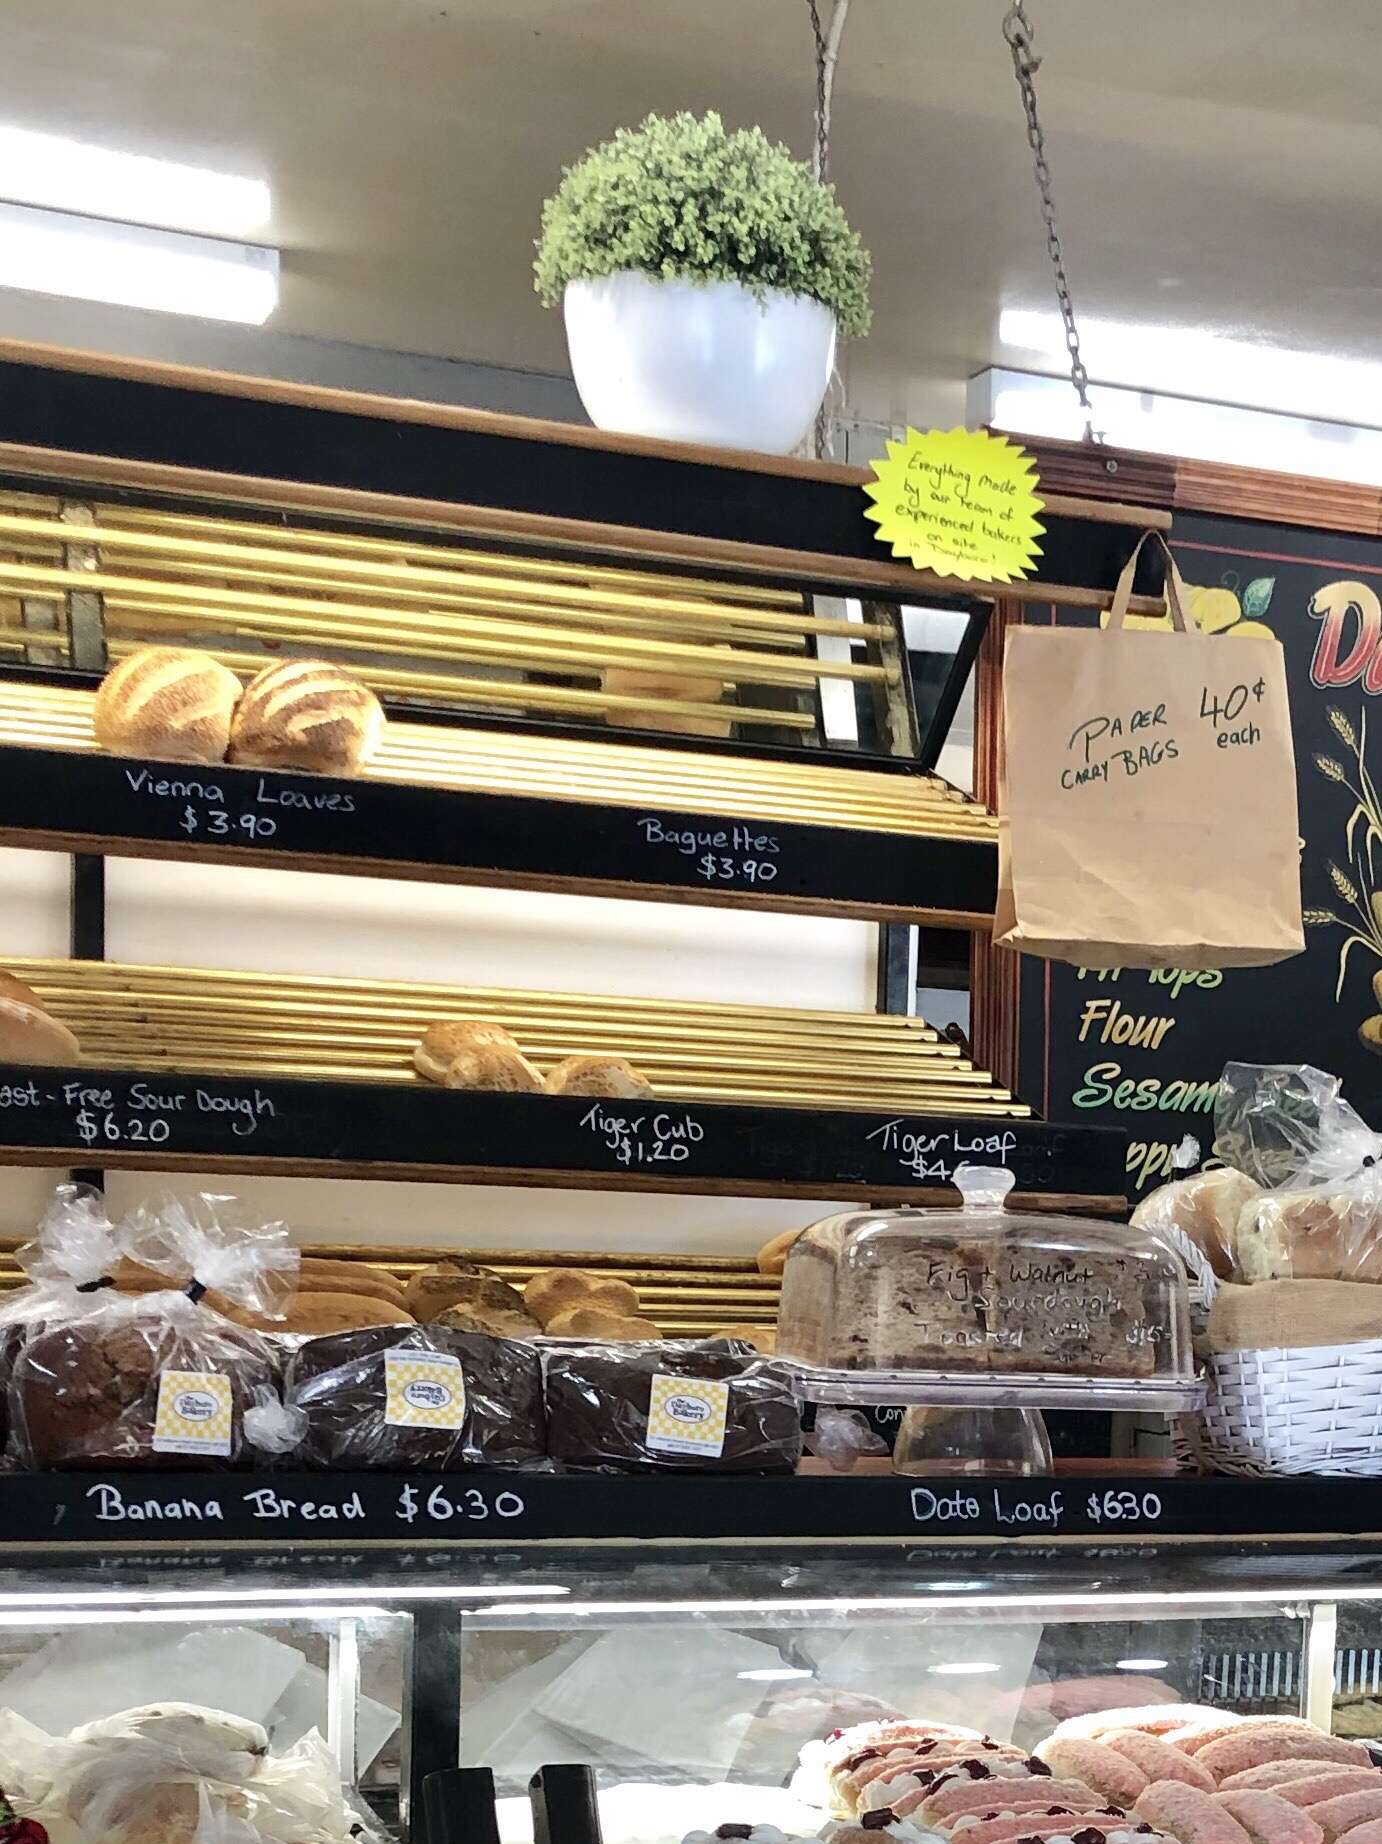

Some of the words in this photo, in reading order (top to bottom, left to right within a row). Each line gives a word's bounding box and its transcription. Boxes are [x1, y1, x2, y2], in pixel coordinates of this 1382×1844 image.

[904, 477, 920, 508] by
[930, 491, 950, 504] our
[999, 507, 1014, 521] of
[1112, 739, 1179, 778] BAGS
[1216, 721, 1262, 748] each
[126, 769, 225, 804] Vienna
[256, 777, 358, 813] Loaves
[179, 808, 277, 839] $3.90
[637, 818, 781, 855] Baguettes
[696, 852, 778, 882] $3.90
[1079, 999, 1176, 1049] Flour
[64, 1083, 115, 1110] Free
[128, 1086, 183, 1113] Sour
[195, 1088, 276, 1136] Dough
[1072, 1062, 1224, 1114] Sesam
[76, 1110, 171, 1144] $6.20
[579, 1101, 646, 1152] Tiger
[652, 1113, 704, 1143] Cub
[866, 1120, 950, 1167] Tiger
[954, 1131, 1017, 1163] Loaf
[616, 1139, 690, 1166] $1.20
[87, 1483, 222, 1521] Banana
[244, 1489, 365, 1521] Bread
[397, 1485, 525, 1522] $6.30
[911, 1489, 980, 1521] Date
[995, 1489, 1064, 1523] Loaf
